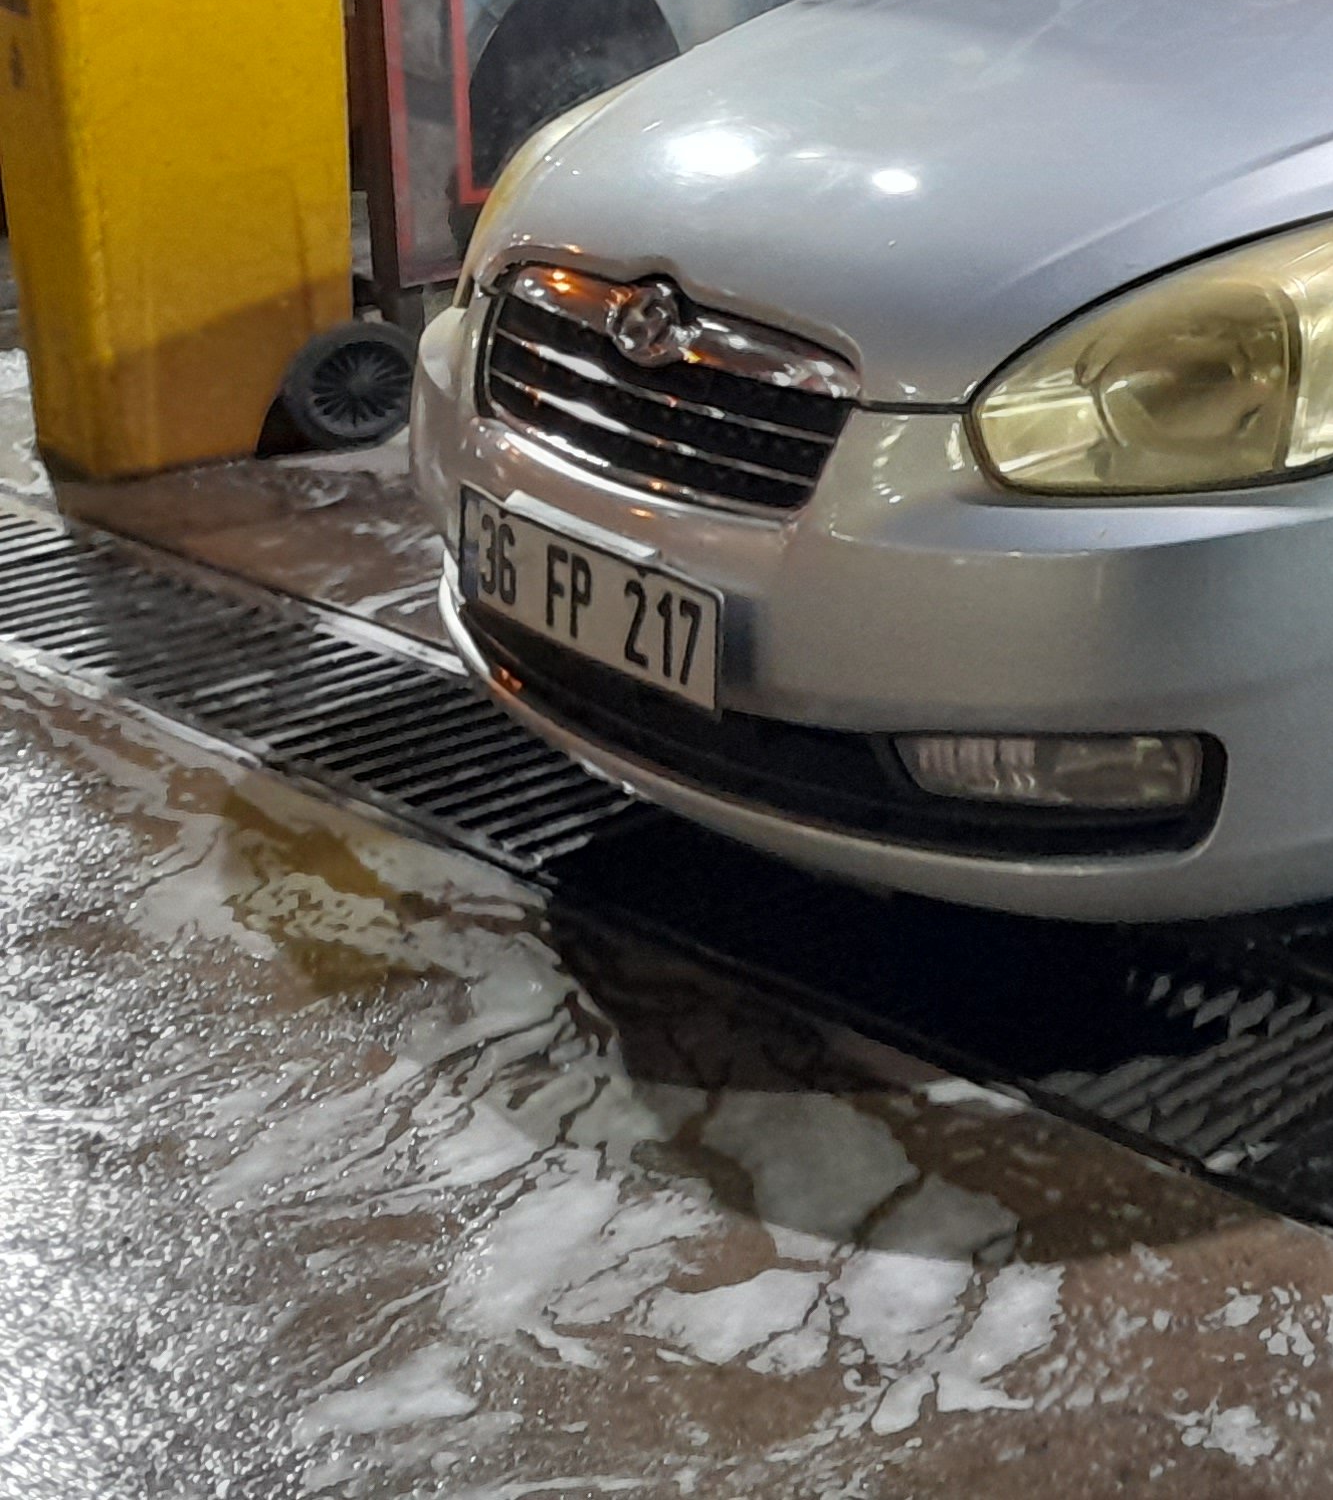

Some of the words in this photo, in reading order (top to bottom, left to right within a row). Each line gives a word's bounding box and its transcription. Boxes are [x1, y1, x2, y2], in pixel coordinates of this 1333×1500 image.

[480, 514, 516, 605] 36
[546, 546, 592, 638] FP
[624, 579, 702, 685] 217
